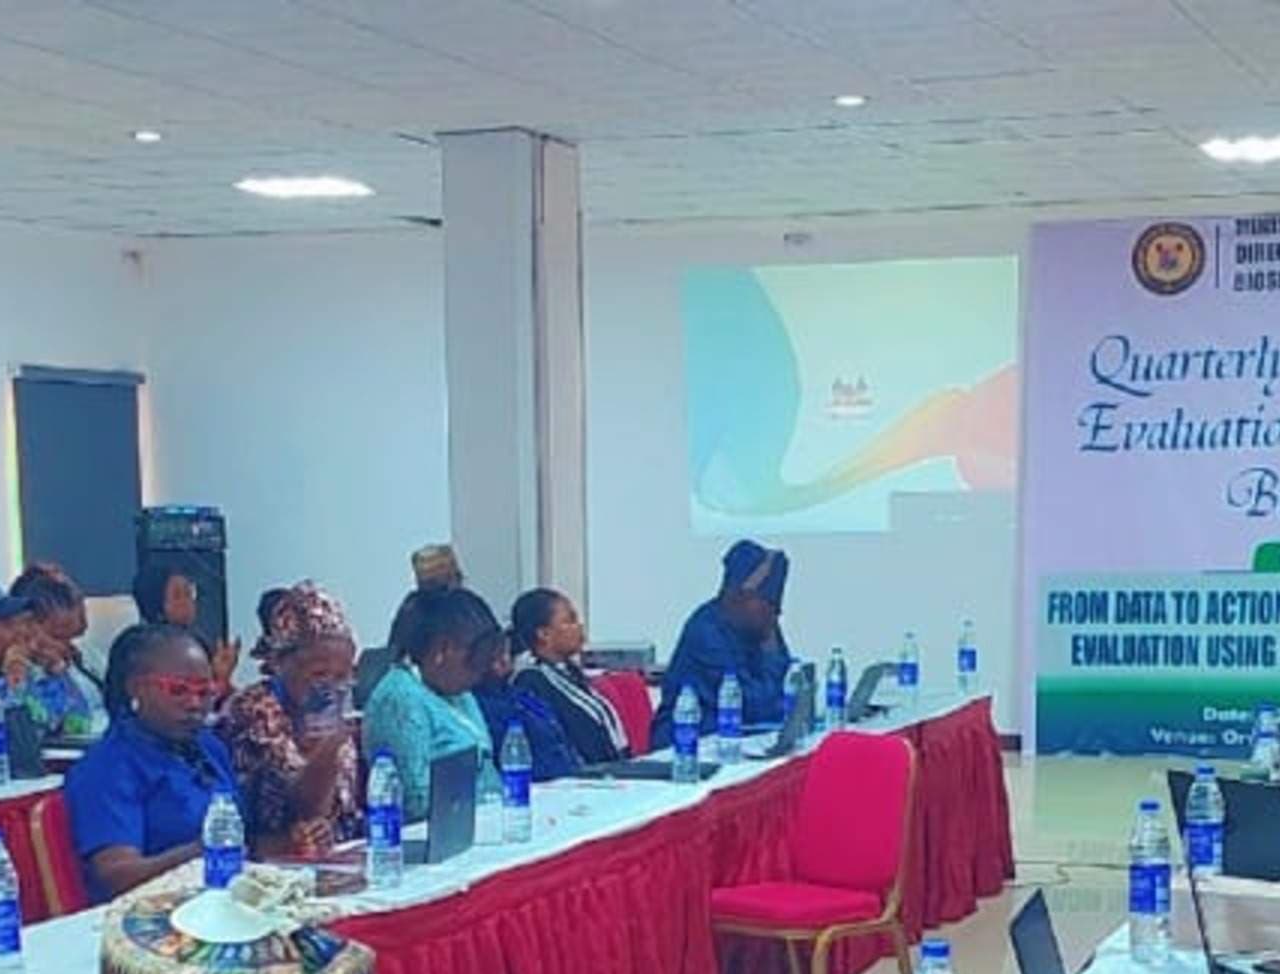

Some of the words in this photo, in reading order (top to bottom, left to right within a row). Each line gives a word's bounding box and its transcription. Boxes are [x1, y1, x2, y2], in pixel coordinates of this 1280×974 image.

[1046, 590, 1110, 625] FROM
[1115, 590, 1167, 625] DATA
[1171, 590, 1200, 625] TO
[1071, 633, 1200, 667] EVALUATION
[1206, 633, 1277, 667] USING
